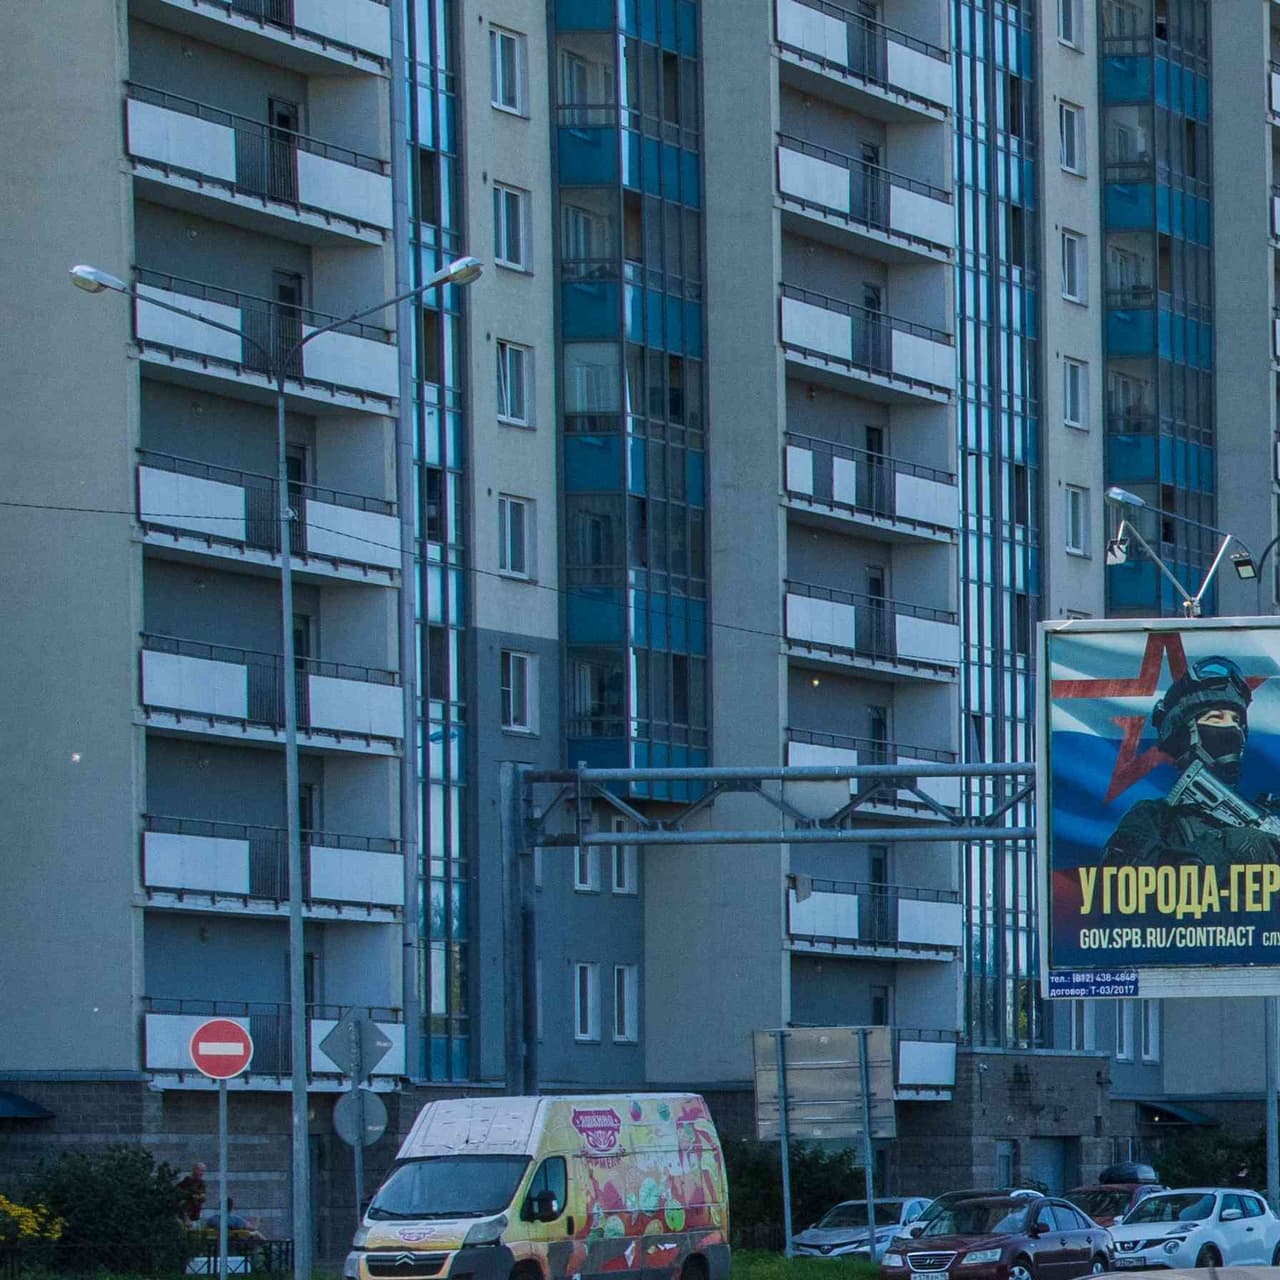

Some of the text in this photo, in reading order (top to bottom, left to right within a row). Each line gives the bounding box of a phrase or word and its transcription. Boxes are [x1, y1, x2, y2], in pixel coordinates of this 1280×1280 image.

[1078, 867, 1097, 915] У
[1079, 926, 1255, 949] GOV.SPB.RU/CONTRACT
[1072, 973, 1094, 983] (812)
[1050, 988, 1089, 997] договор:
